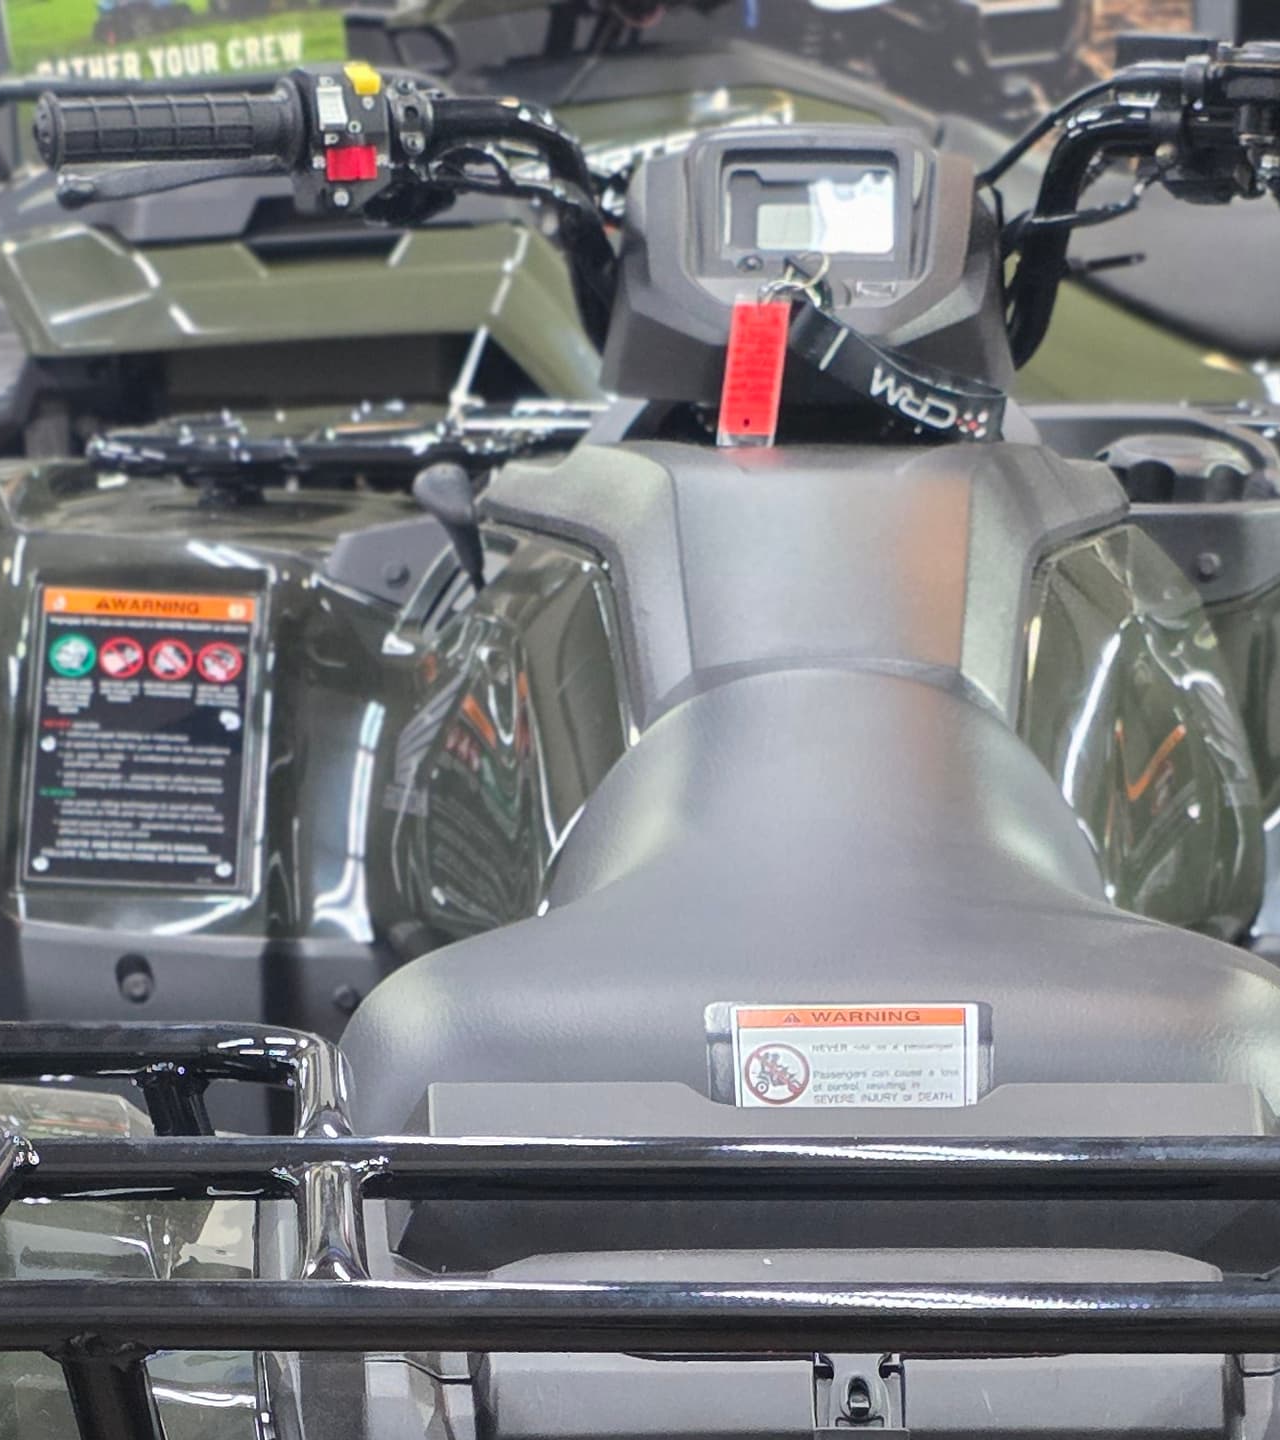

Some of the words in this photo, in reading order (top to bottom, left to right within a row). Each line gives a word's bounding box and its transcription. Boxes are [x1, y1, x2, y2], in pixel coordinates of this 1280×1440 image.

[148, 42, 220, 78] YOUR
[227, 30, 303, 69] CREW
[870, 366, 958, 429] CRM
[111, 598, 200, 615] WARNING
[811, 1010, 921, 1023] WARNING
[812, 1043, 848, 1053] NEVER
[812, 1069, 868, 1081] Passengers
[814, 1093, 856, 1104] SEVERE
[861, 1092, 898, 1103] INJURY
